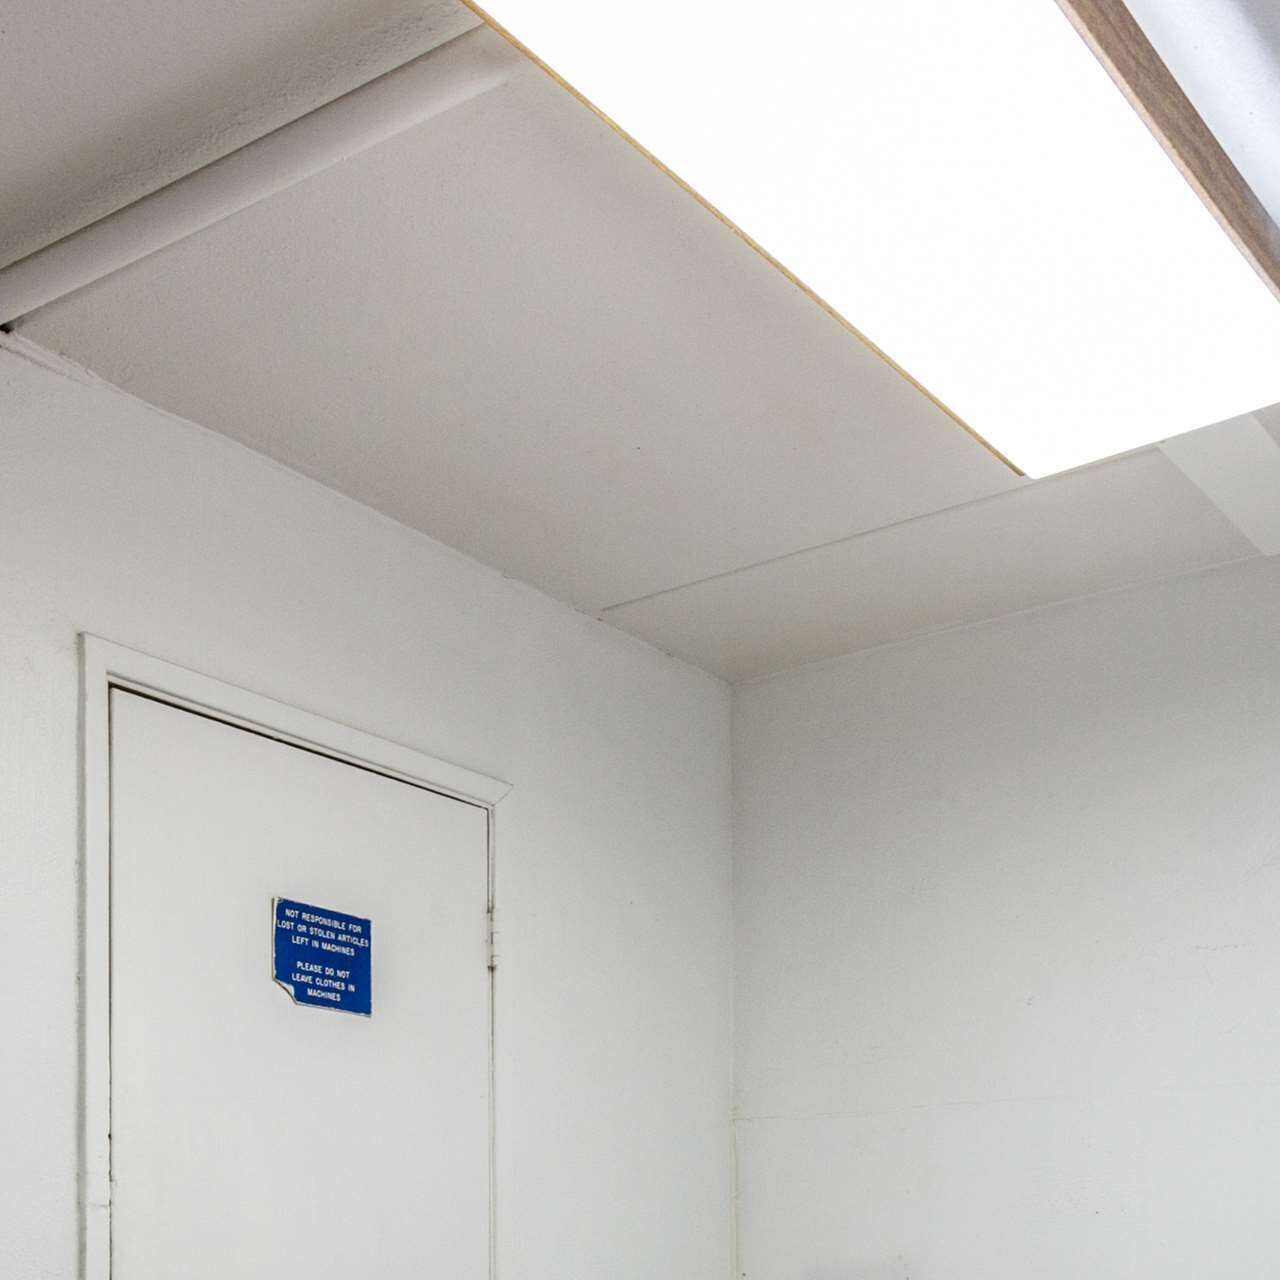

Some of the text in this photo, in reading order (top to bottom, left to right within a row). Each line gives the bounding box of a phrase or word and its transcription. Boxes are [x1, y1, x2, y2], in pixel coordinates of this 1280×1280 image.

[285, 908, 362, 933] NOT RESPONSIBLE FOR
[277, 920, 368, 947] LOST OR STOLEN ARTICLES
[292, 935, 355, 956] LEFT IN MACHINES
[297, 961, 350, 978] PLEASE DO NOT
[292, 973, 355, 992] LEAVE CLOTHES IN
[307, 988, 341, 1001] MACHINES
